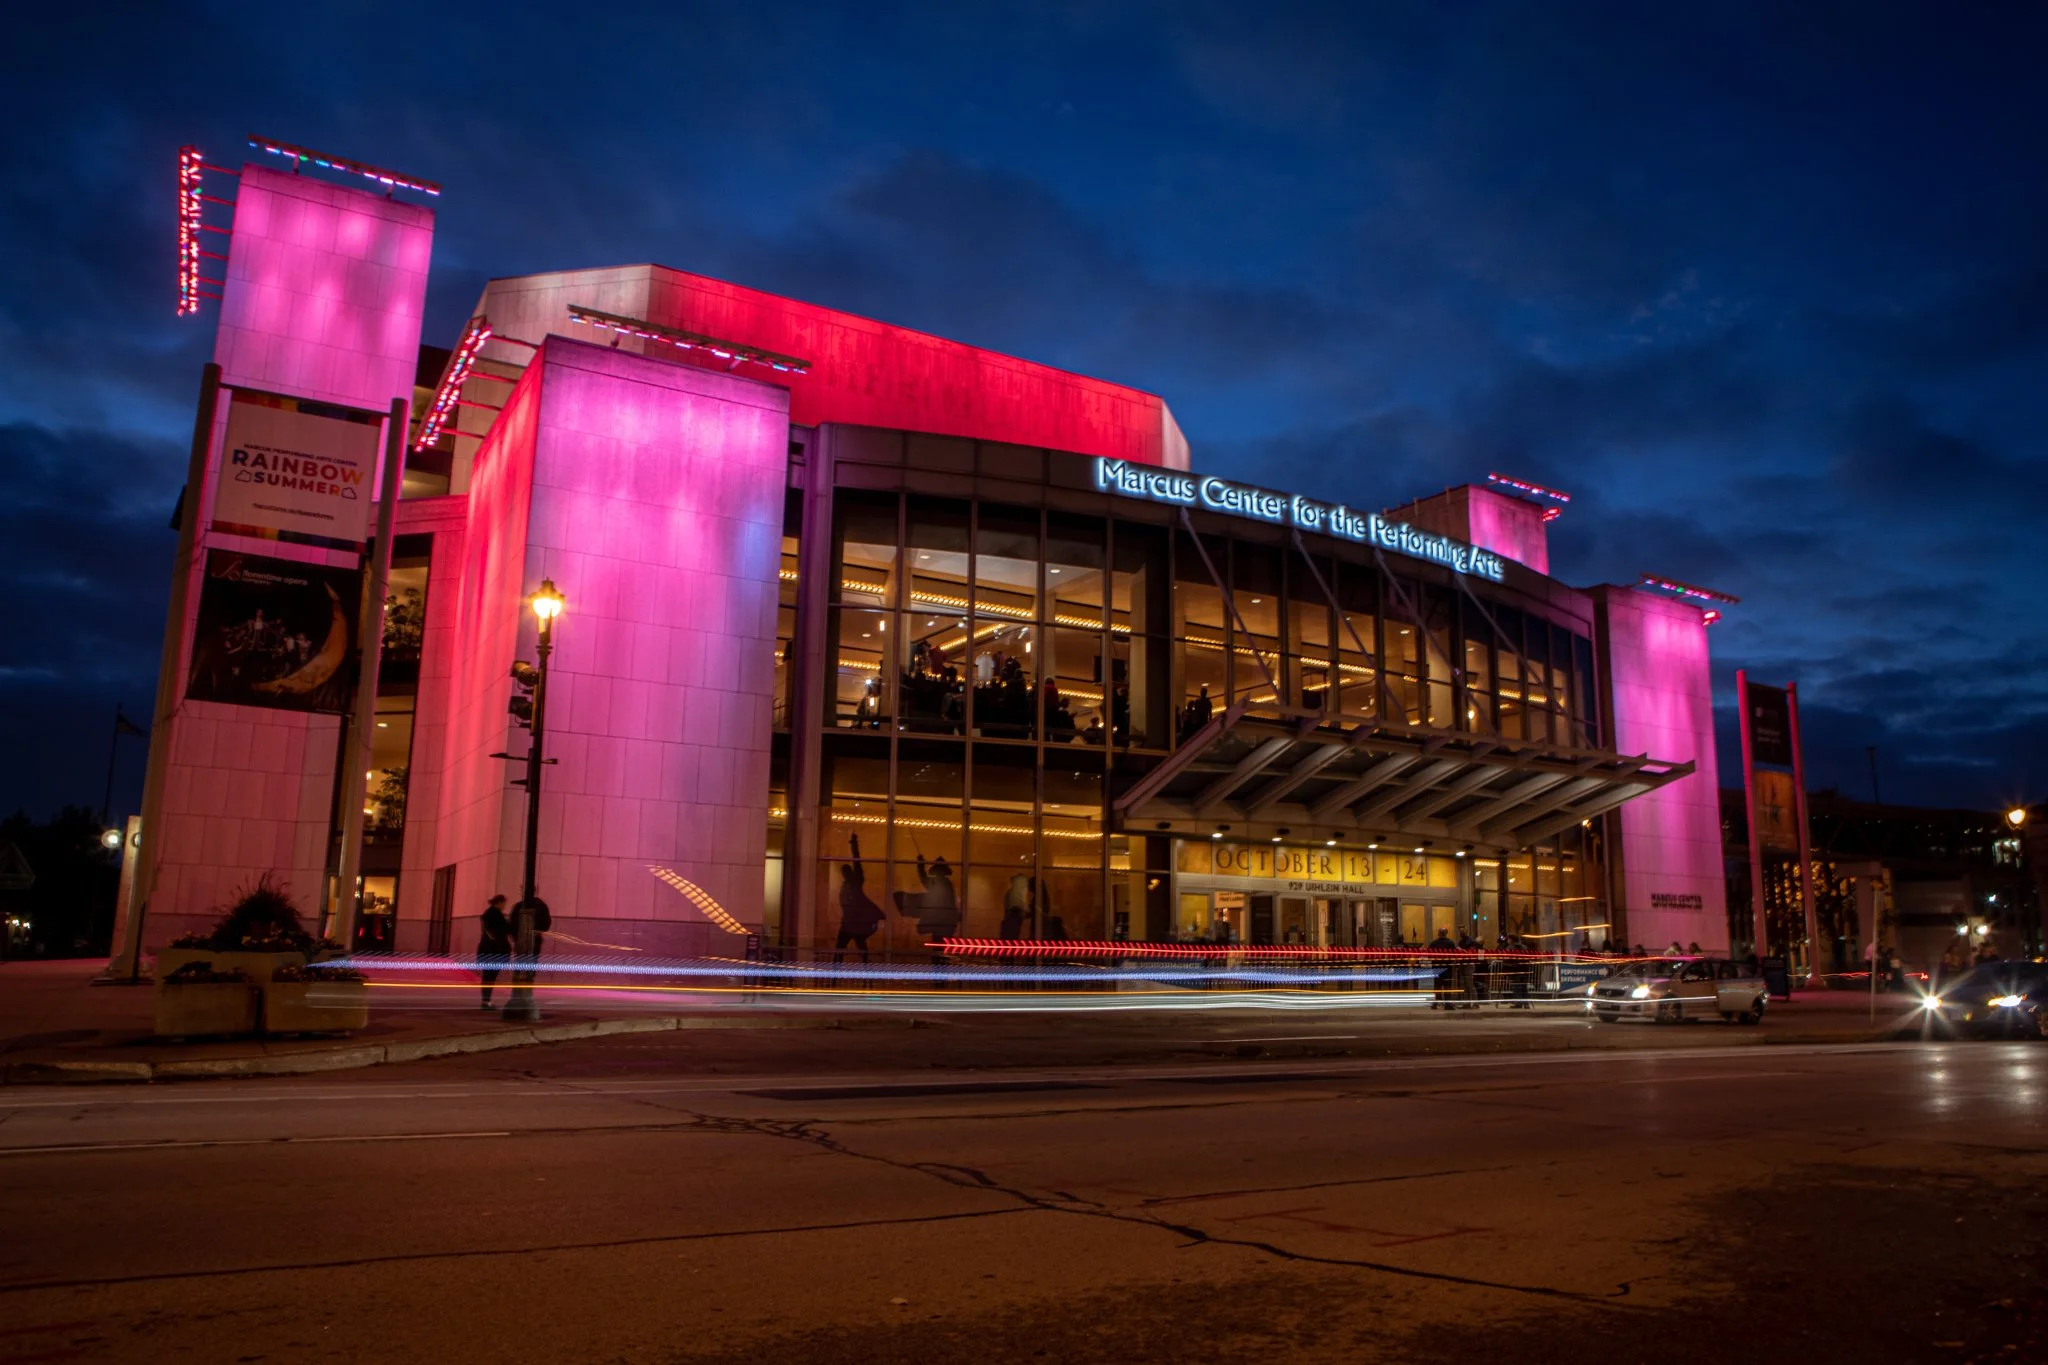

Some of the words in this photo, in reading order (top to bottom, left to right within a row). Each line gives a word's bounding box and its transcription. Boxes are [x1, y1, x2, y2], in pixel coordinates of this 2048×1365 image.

[232, 449, 364, 485] RAINBOW
[253, 471, 341, 496] SUMMER
[1097, 456, 1196, 502] Marcus
[1202, 475, 1288, 519] Center
[1292, 495, 1327, 529] for
[1331, 504, 1366, 539] the
[1469, 545, 1505, 584] Arts
[283, 576, 308, 586] opera
[1215, 847, 1334, 876] OCTOBER
[1349, 855, 1371, 877] 13
[1403, 859, 1426, 881] 24
[1288, 881, 1303, 891] 929
[1305, 882, 1340, 893] UIHLEIN
[1342, 884, 1365, 894] HALL
[1560, 968, 1598, 976] PERFORMANCE
